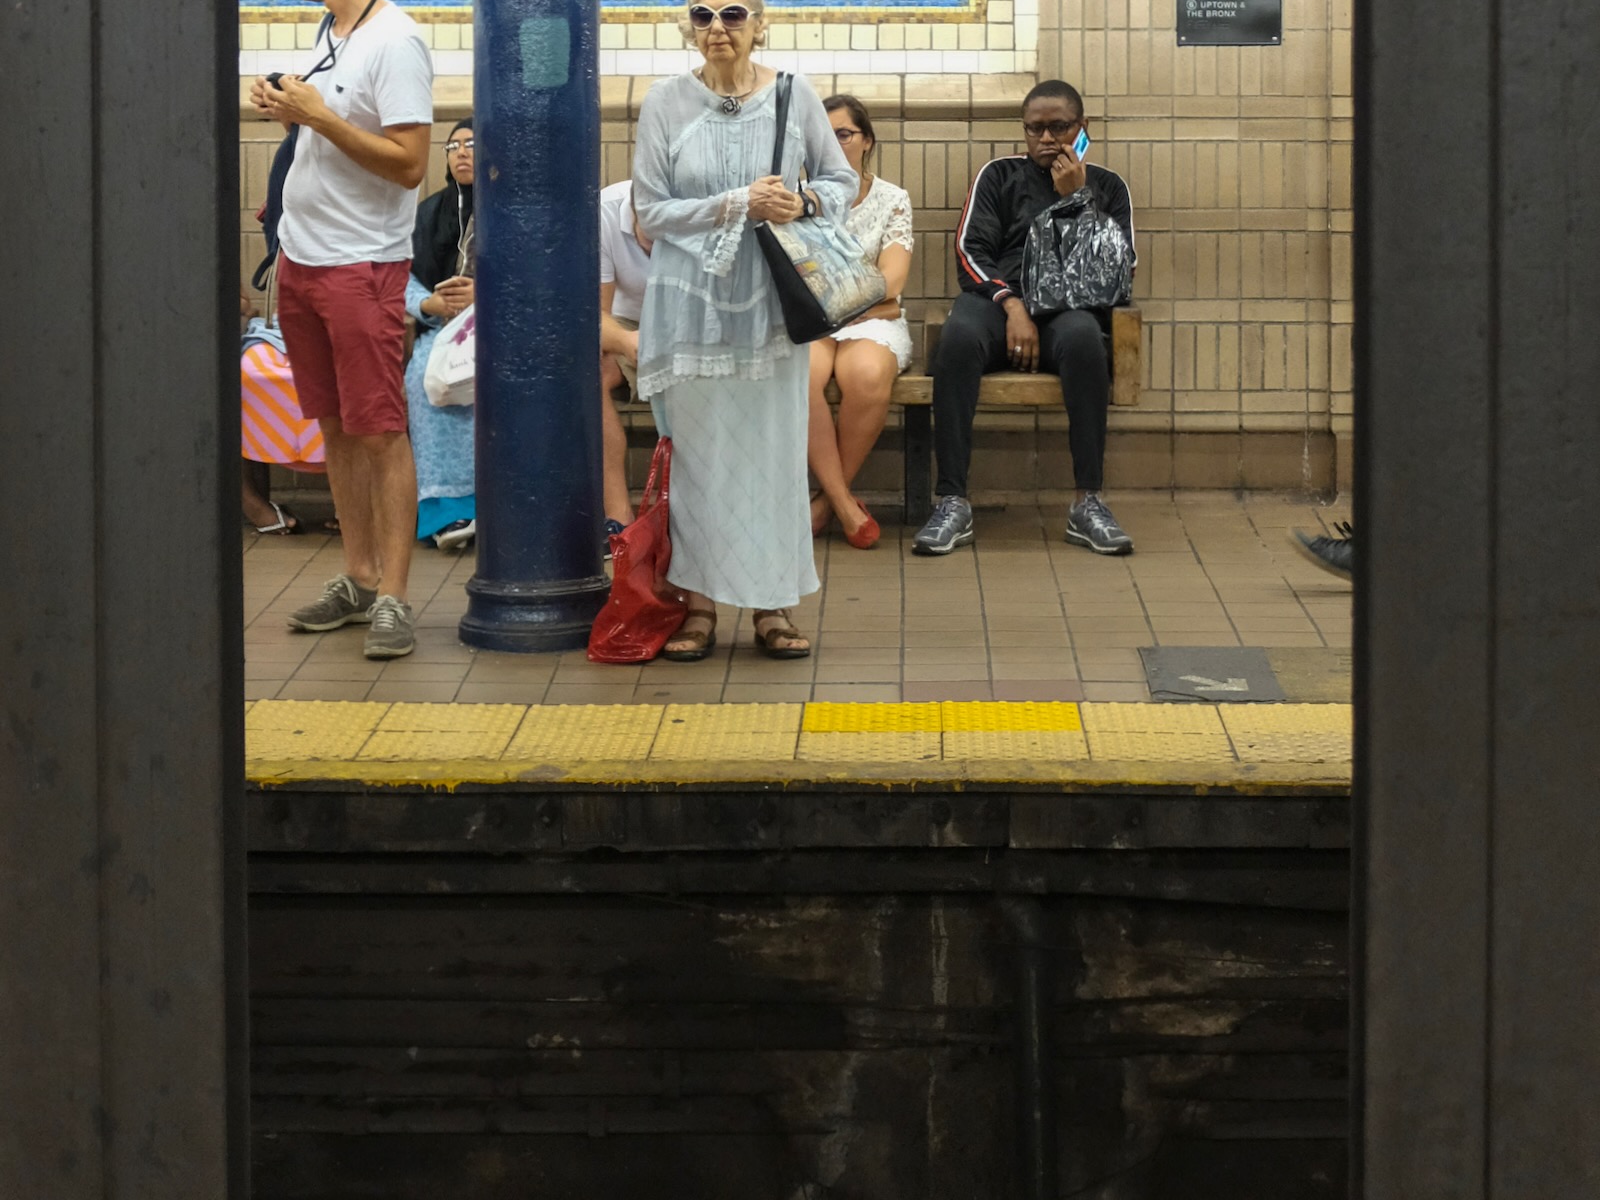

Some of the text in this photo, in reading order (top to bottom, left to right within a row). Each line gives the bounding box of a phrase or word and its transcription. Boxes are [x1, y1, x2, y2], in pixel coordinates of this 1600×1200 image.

[1200, 1, 1237, 9] UPTOWN
[1239, 1, 1246, 9] &
[1186, 9, 1236, 17] THE BRONX
